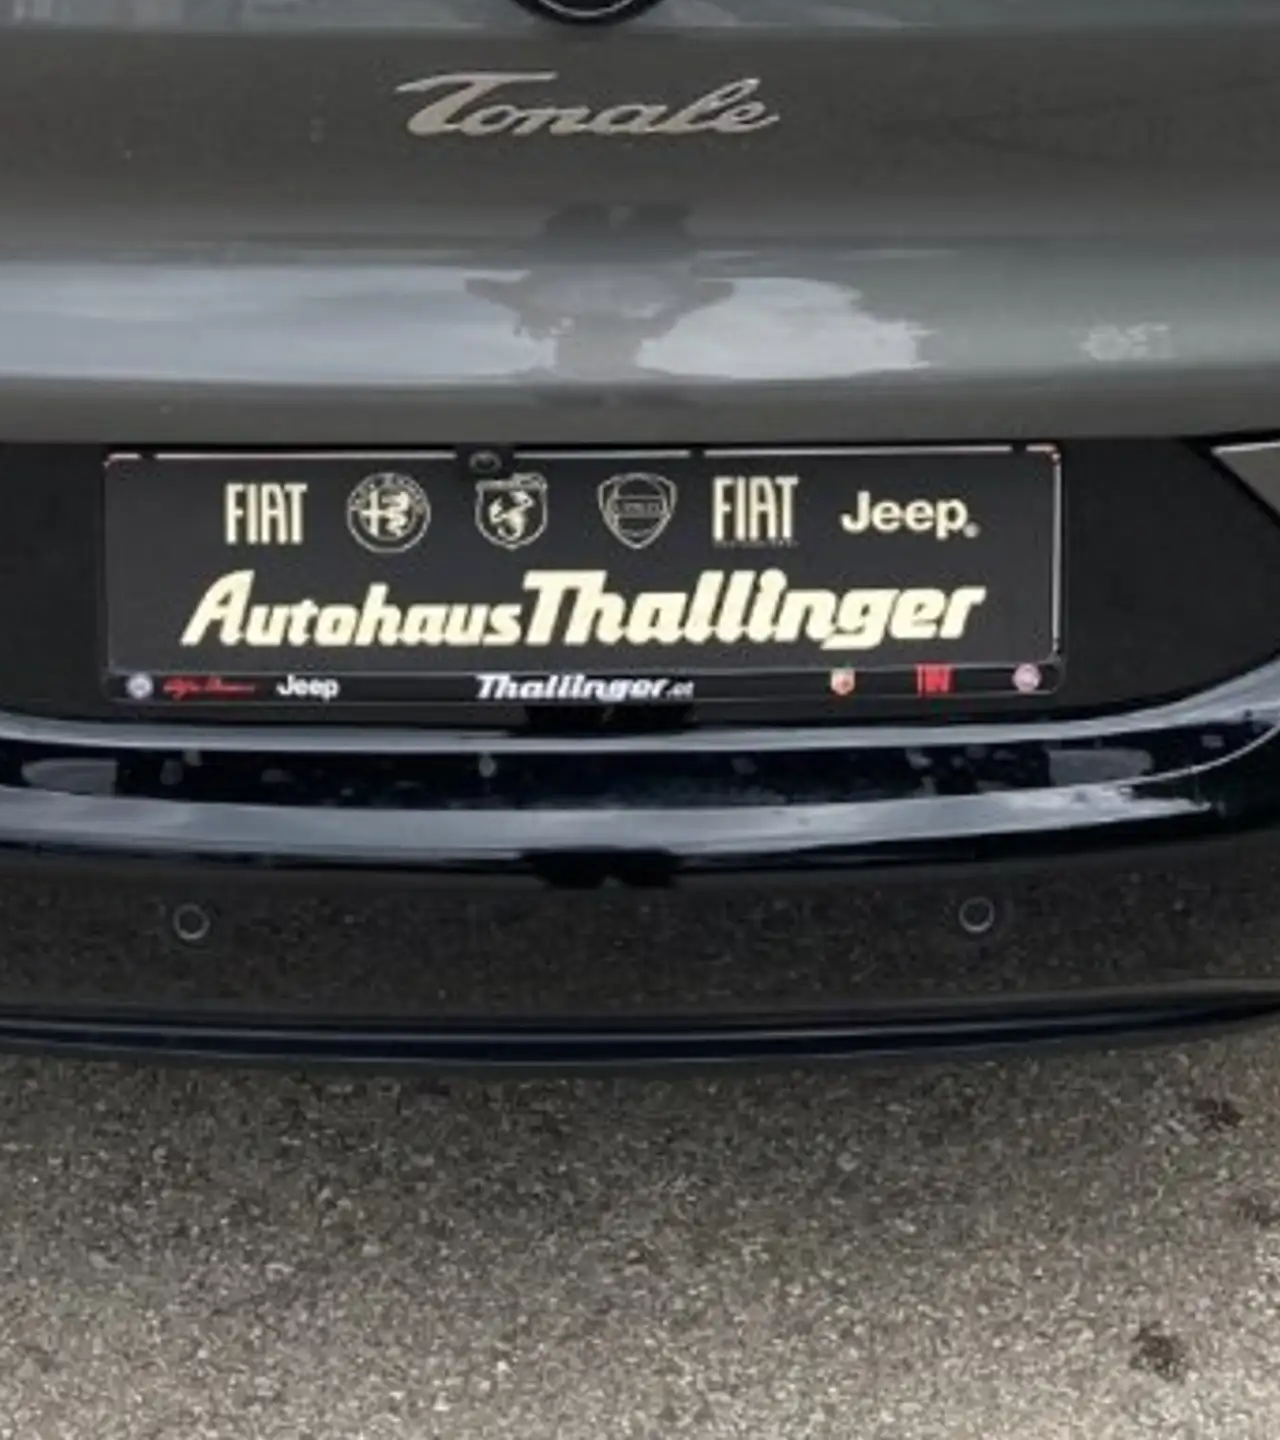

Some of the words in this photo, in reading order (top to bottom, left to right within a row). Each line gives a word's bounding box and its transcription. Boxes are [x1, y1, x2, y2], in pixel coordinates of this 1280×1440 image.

[396, 71, 780, 137] Tonale
[224, 482, 308, 545] FIAT
[712, 475, 800, 541] FIAT
[839, 489, 970, 541] Jeep
[276, 673, 341, 703] Jeep
